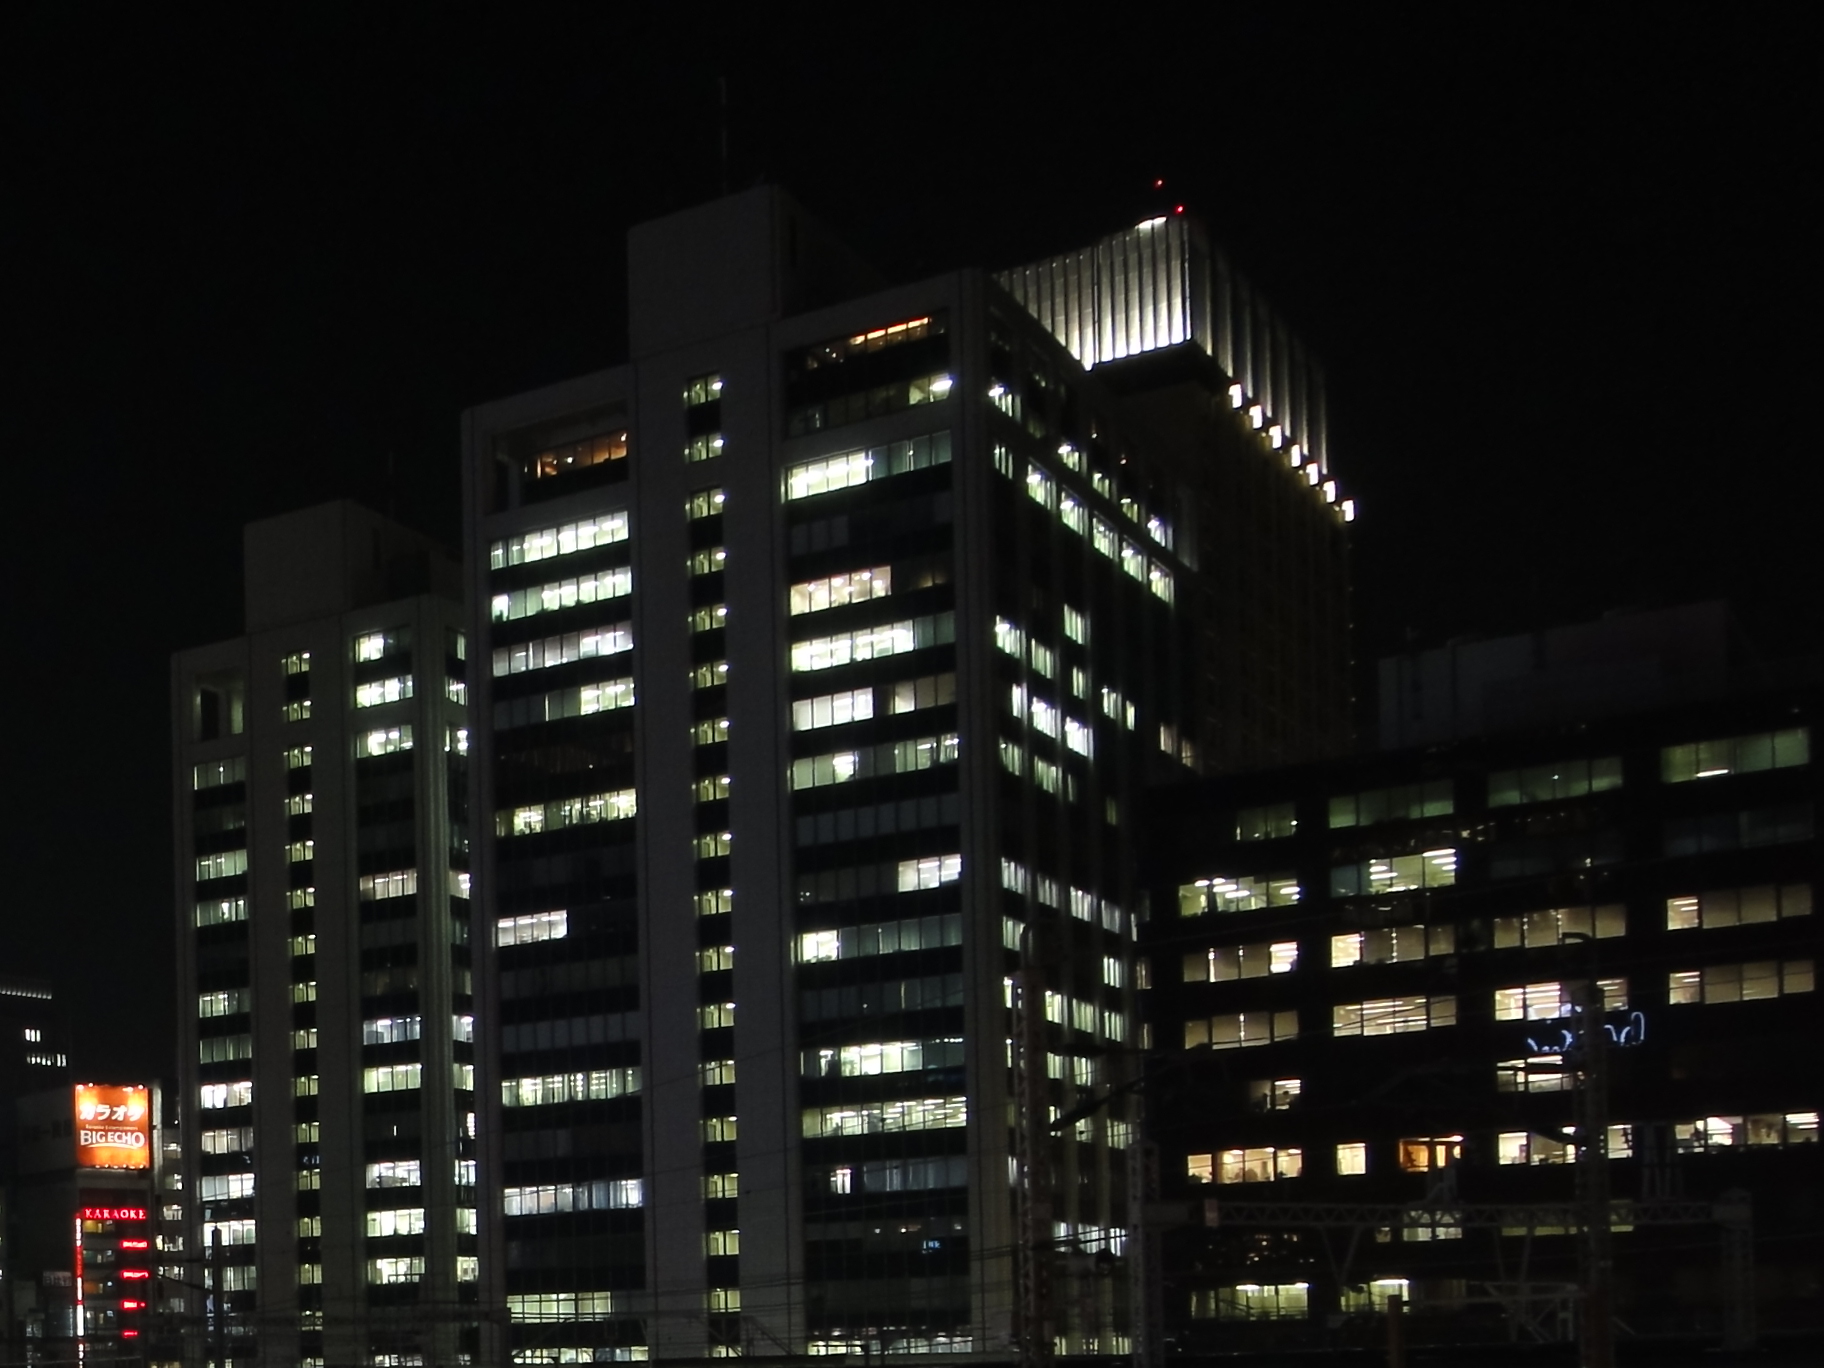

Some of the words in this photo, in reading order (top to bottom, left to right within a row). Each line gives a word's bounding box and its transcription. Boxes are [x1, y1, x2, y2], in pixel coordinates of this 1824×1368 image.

[79, 1103, 145, 1121] カラオケ
[80, 1130, 106, 1146] BIG
[107, 1131, 145, 1148] ECHO
[84, 1208, 146, 1219] KARAOKE
